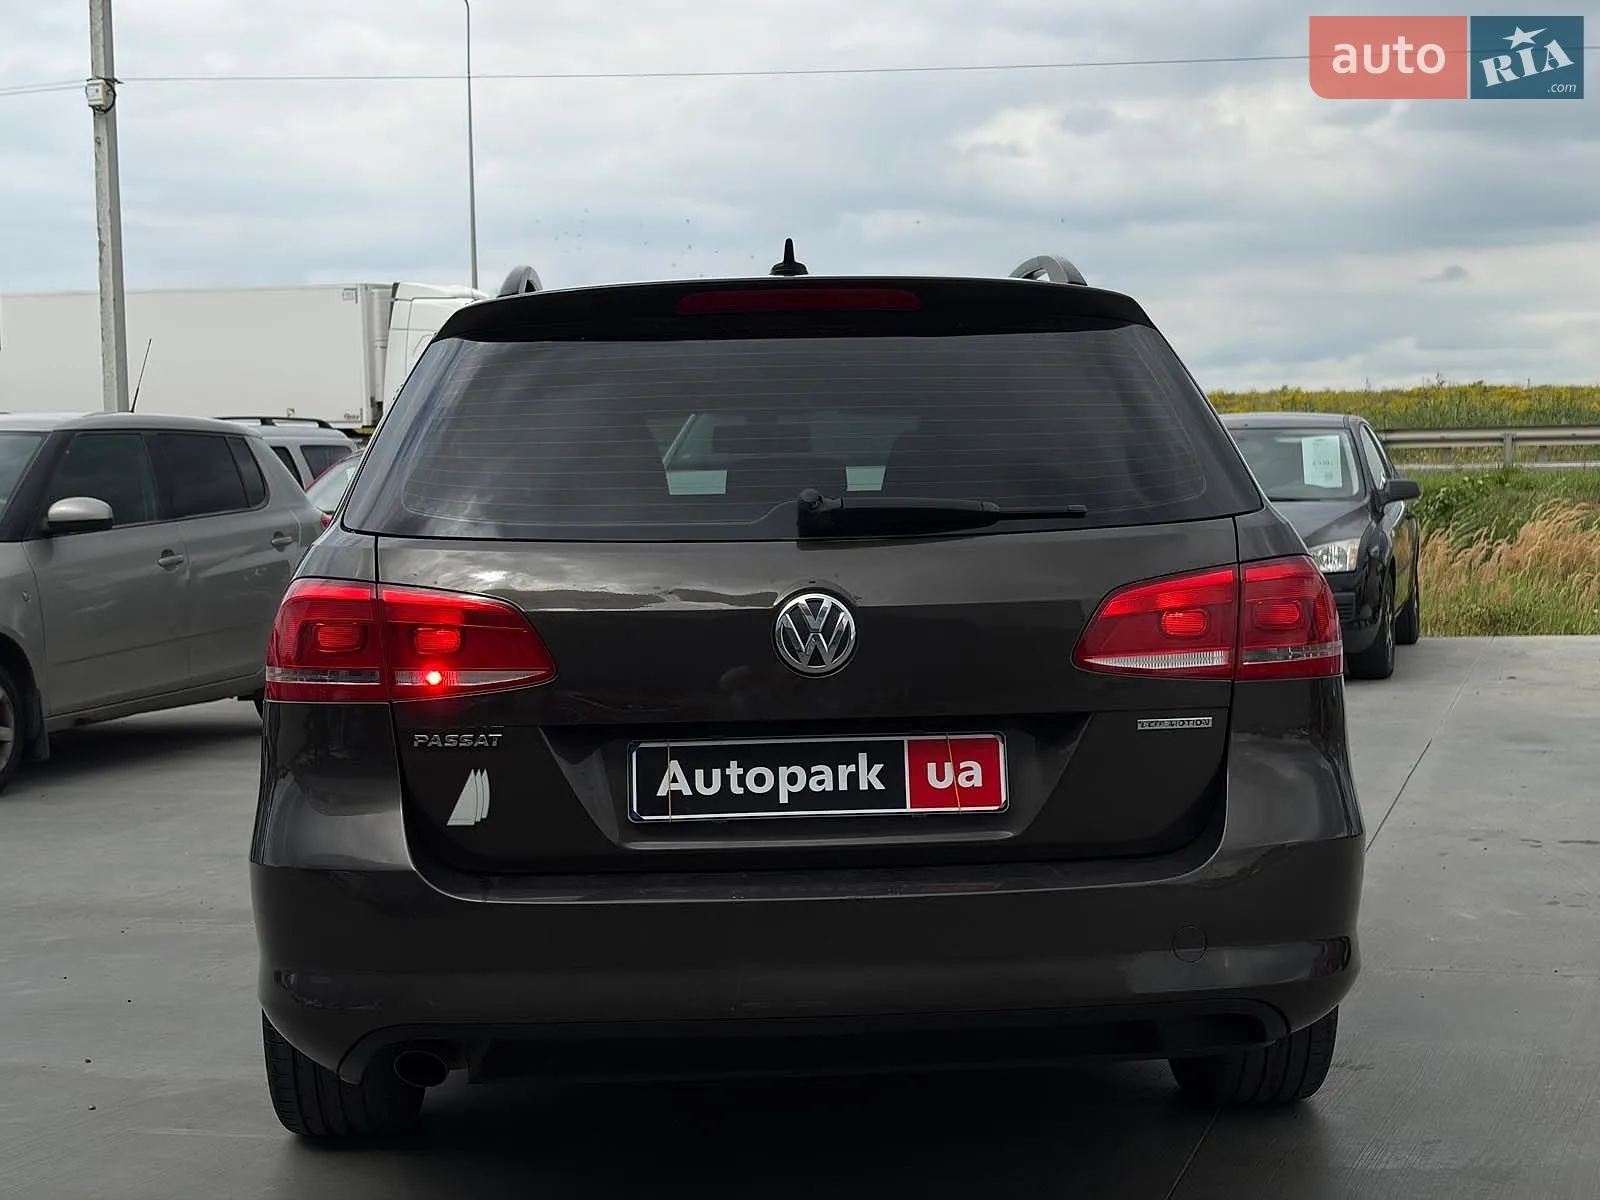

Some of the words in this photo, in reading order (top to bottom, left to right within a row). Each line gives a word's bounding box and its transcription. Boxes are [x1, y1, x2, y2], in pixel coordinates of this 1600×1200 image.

[413, 733, 503, 747] PASSAT
[656, 752, 886, 804] Autopark
[926, 757, 984, 790] ua
